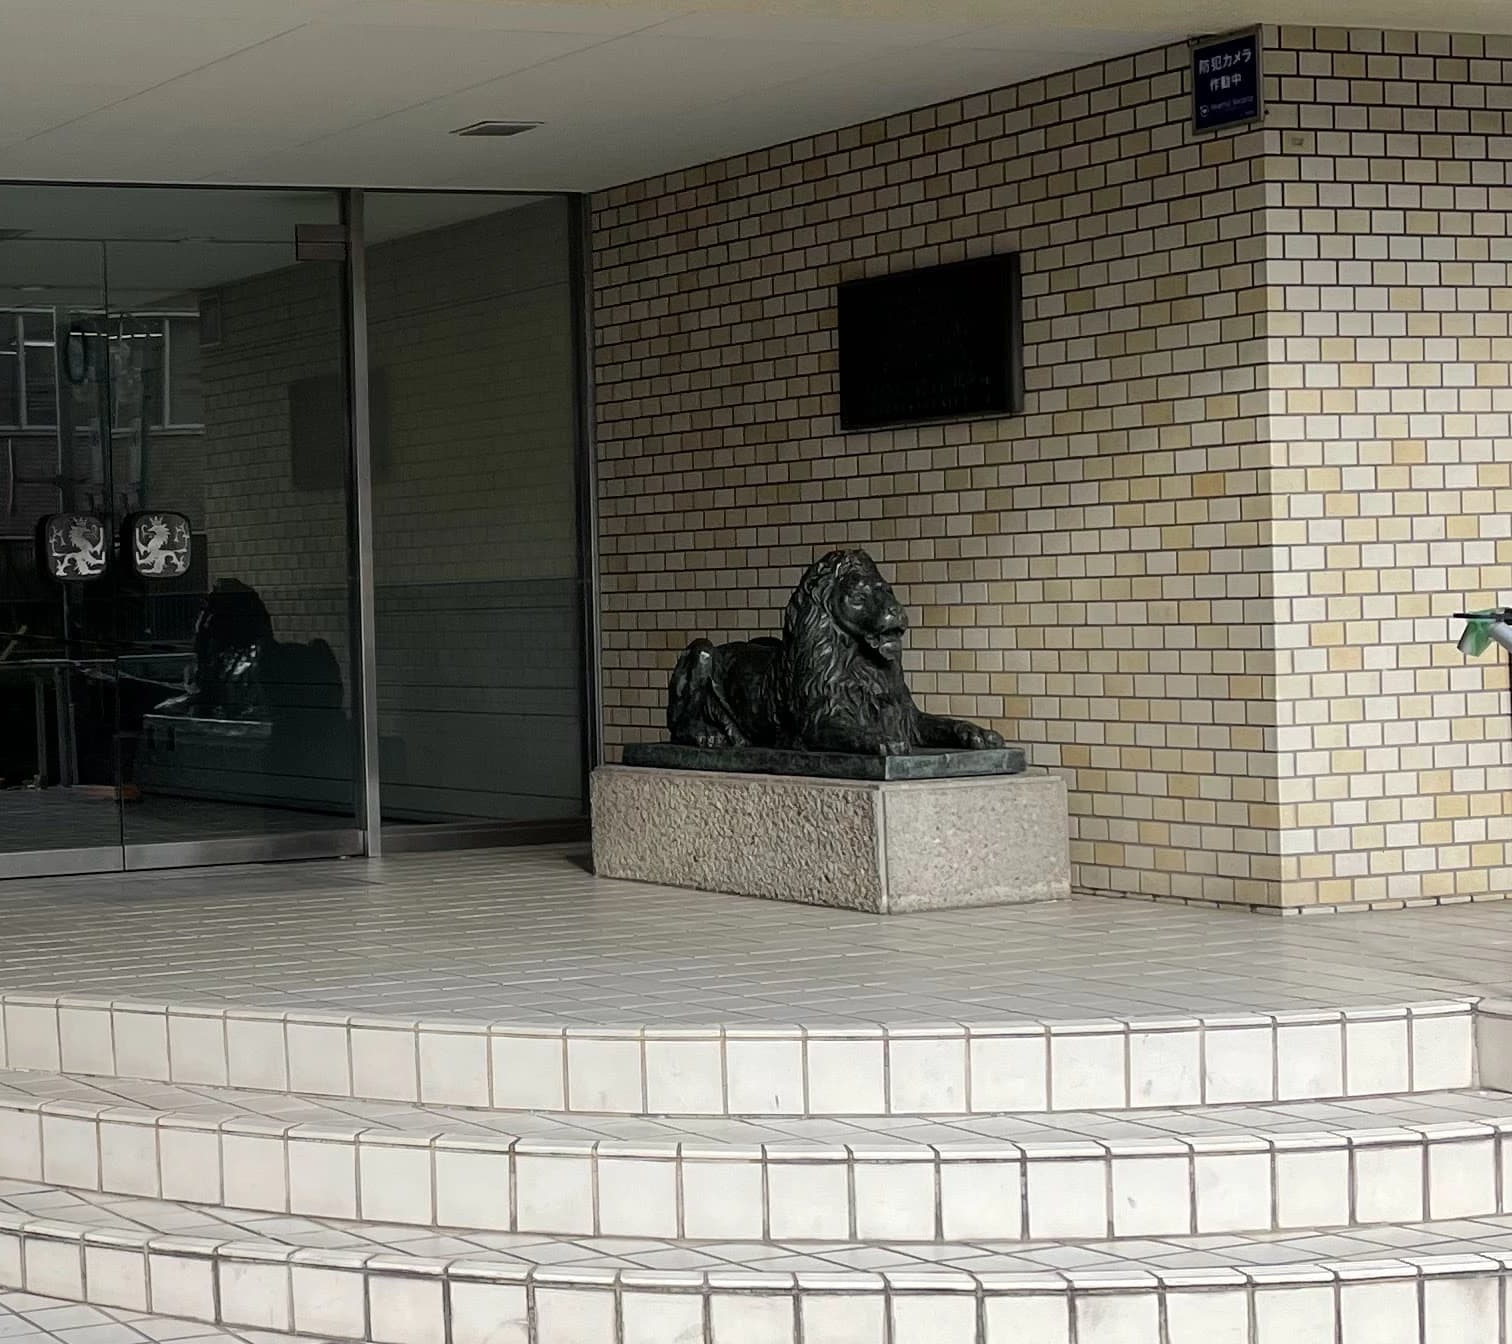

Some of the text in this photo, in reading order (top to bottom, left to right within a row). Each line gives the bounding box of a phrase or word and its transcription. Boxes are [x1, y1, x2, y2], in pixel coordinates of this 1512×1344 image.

[1199, 48, 1252, 74] 防犯カメラ
[1210, 73, 1242, 92] 作動中
